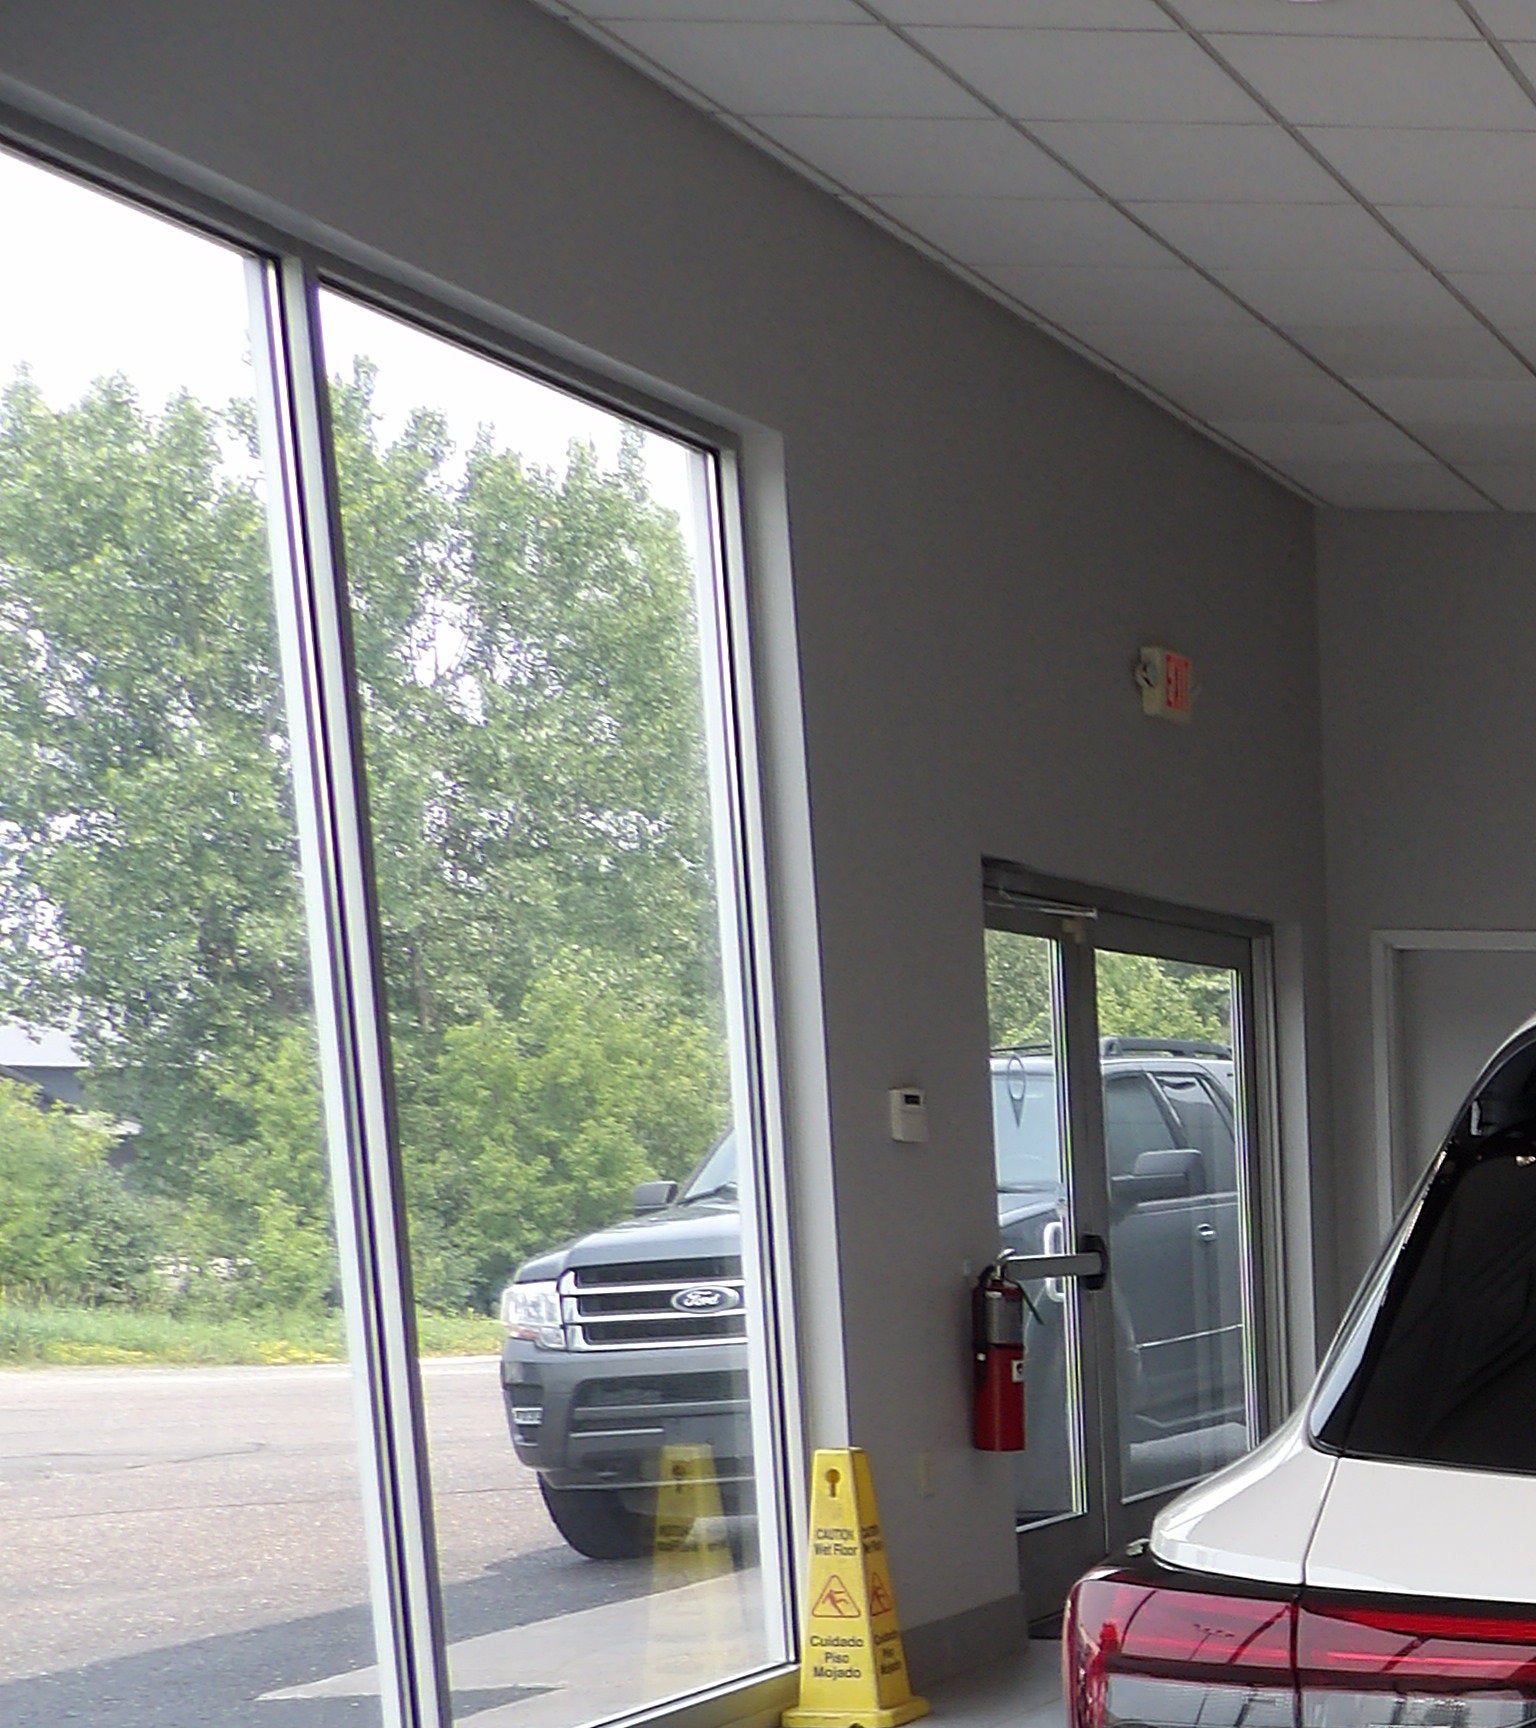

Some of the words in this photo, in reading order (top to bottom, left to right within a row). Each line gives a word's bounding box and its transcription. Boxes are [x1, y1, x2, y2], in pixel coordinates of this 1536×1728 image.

[684, 1289, 721, 1308] Ford
[815, 1528, 854, 1542] CAUTION
[814, 1543, 832, 1556] Wet
[833, 1543, 858, 1557] Floor
[809, 1635, 864, 1648] Cuidado
[824, 1651, 850, 1664] Piso
[813, 1666, 862, 1680] Mojado
